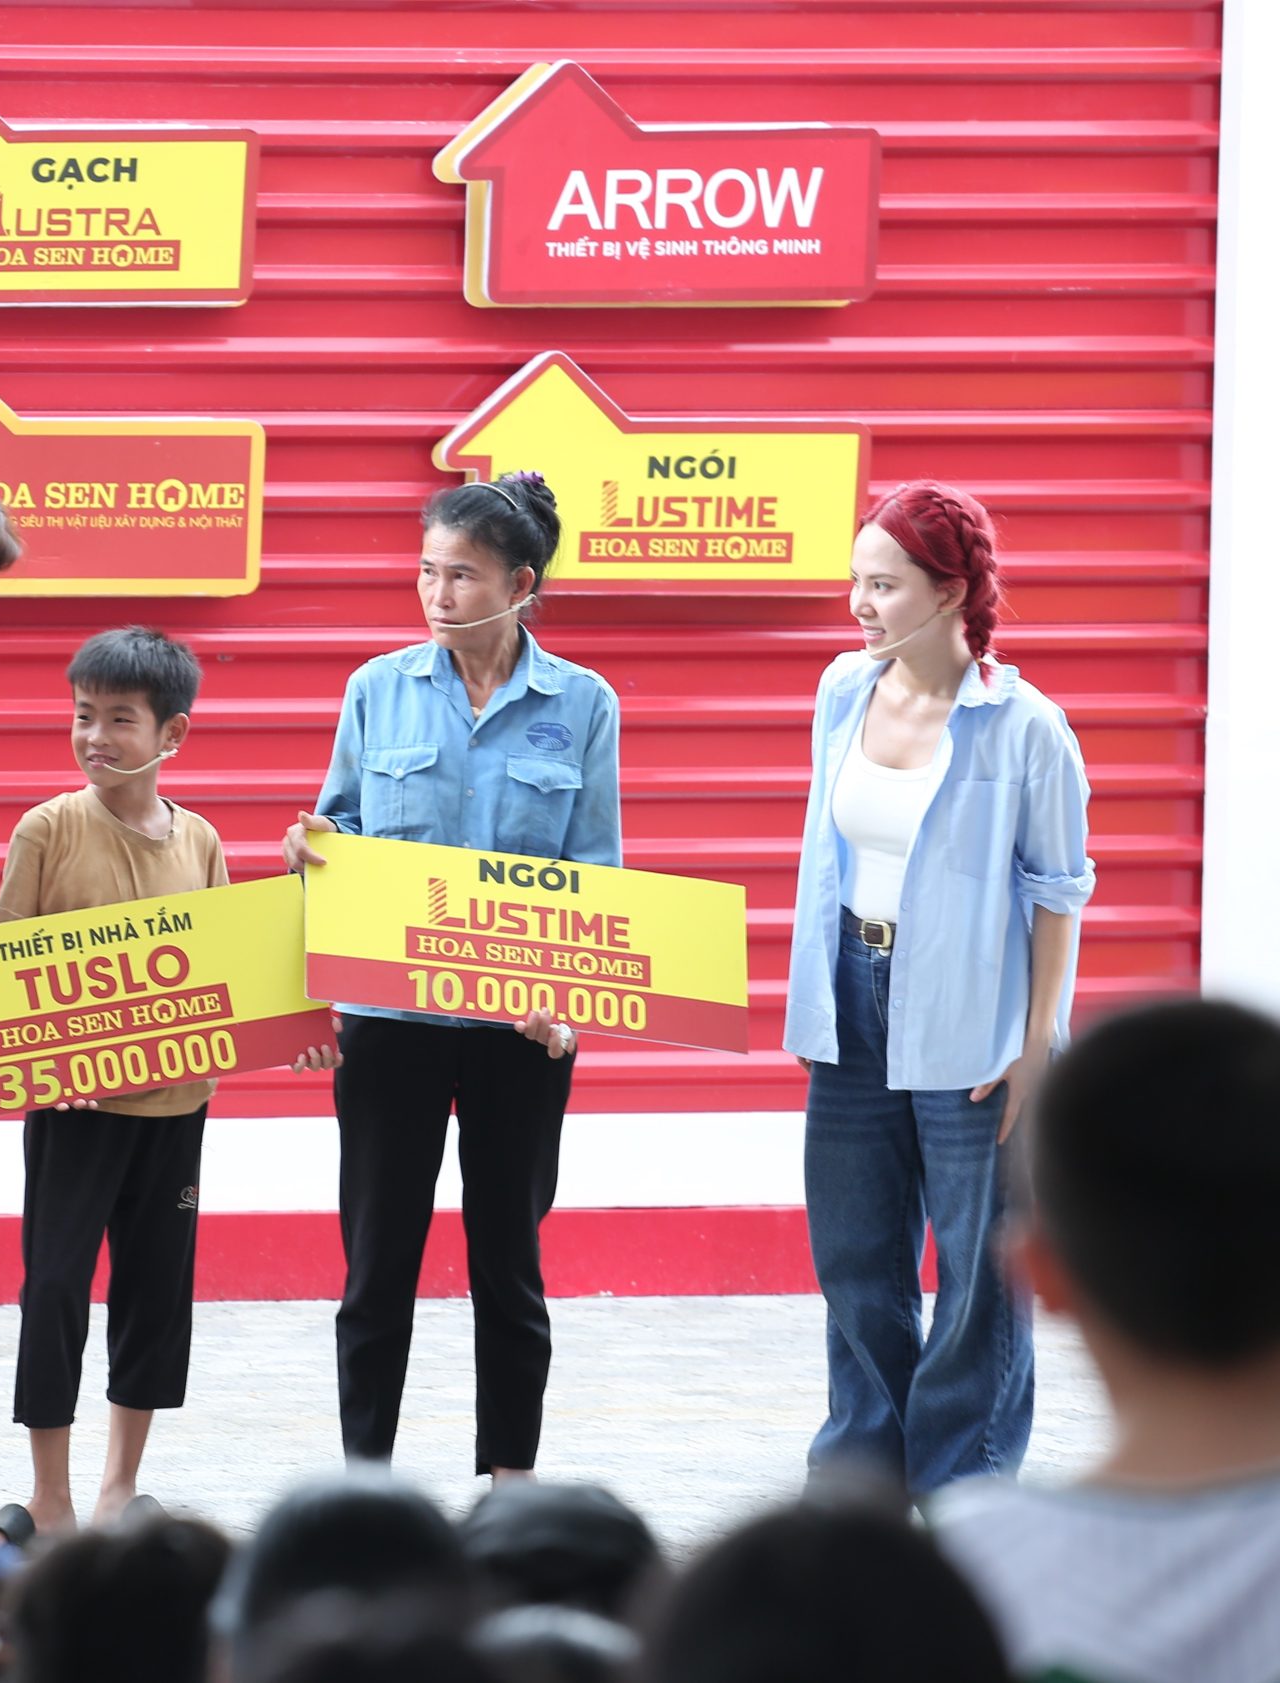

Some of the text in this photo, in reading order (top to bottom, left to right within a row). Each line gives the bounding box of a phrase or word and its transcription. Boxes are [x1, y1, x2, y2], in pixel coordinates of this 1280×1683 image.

[32, 157, 138, 190] GẠCH
[546, 167, 824, 231] ARROW
[33, 247, 86, 266] SEN
[91, 244, 175, 268] HOME
[545, 236, 821, 260] THIẾT BỊ VỆ SINH THÔNG MINH
[647, 449, 736, 480] NGÓI
[44, 482, 119, 509] SEN
[126, 478, 246, 512] HOME
[600, 481, 778, 528] LUSTIME
[177, 516, 187, 529] &
[189, 514, 213, 530] NỘI
[588, 535, 788, 560] HOA SEN HOME
[478, 858, 580, 894] NGÓI
[63, 929, 85, 956] BỊ
[89, 917, 140, 947] NHÀ
[144, 907, 193, 938] TẮM
[427, 877, 631, 949] LUSTIME
[415, 934, 644, 980] HOA SEN HOME
[14, 944, 190, 1011] TUSLO
[68, 1010, 122, 1038] SEN
[131, 993, 222, 1026] HOME
[407, 969, 648, 1032] 10.000.000
